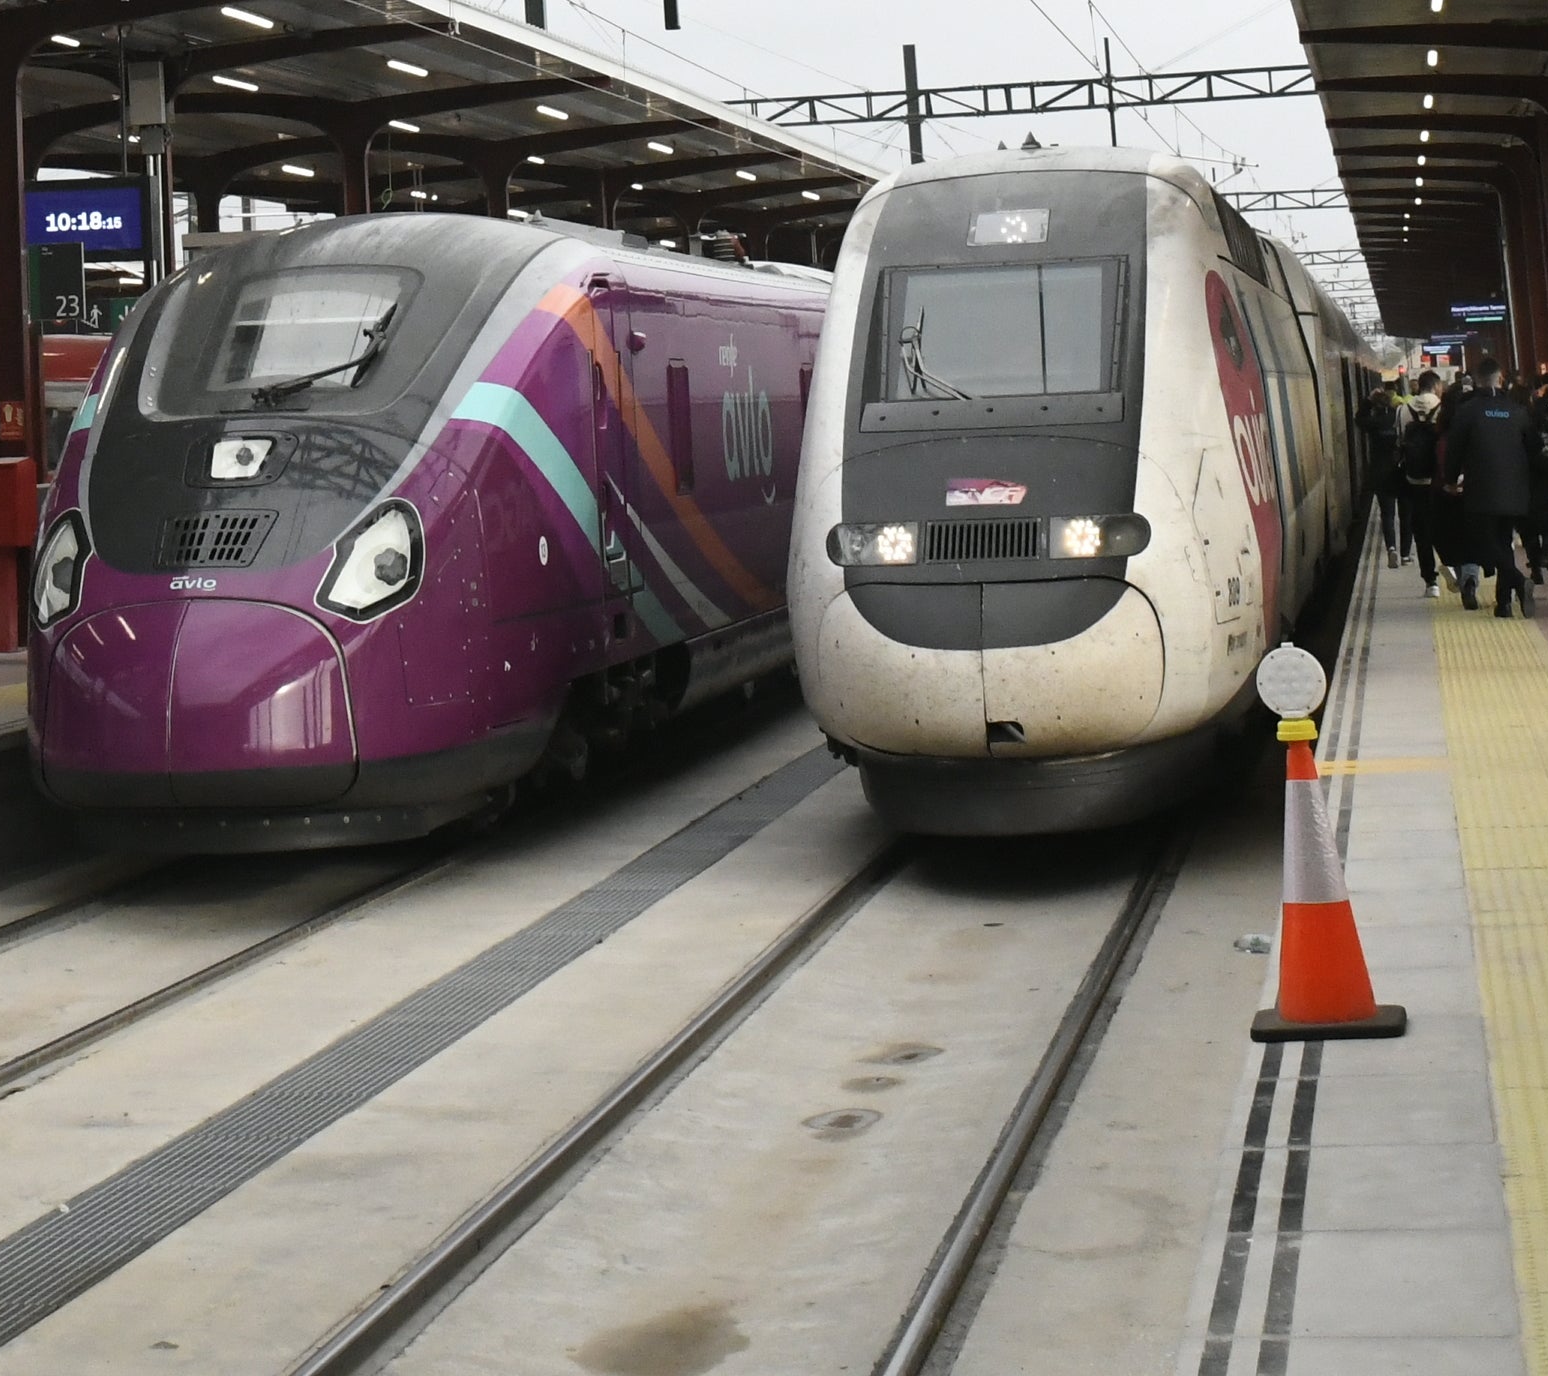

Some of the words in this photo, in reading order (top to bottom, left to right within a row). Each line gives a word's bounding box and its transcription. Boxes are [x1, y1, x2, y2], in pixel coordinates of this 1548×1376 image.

[55, 295, 80, 317] 23
[723, 365, 773, 483] avlo
[170, 577, 217, 590] avlo
